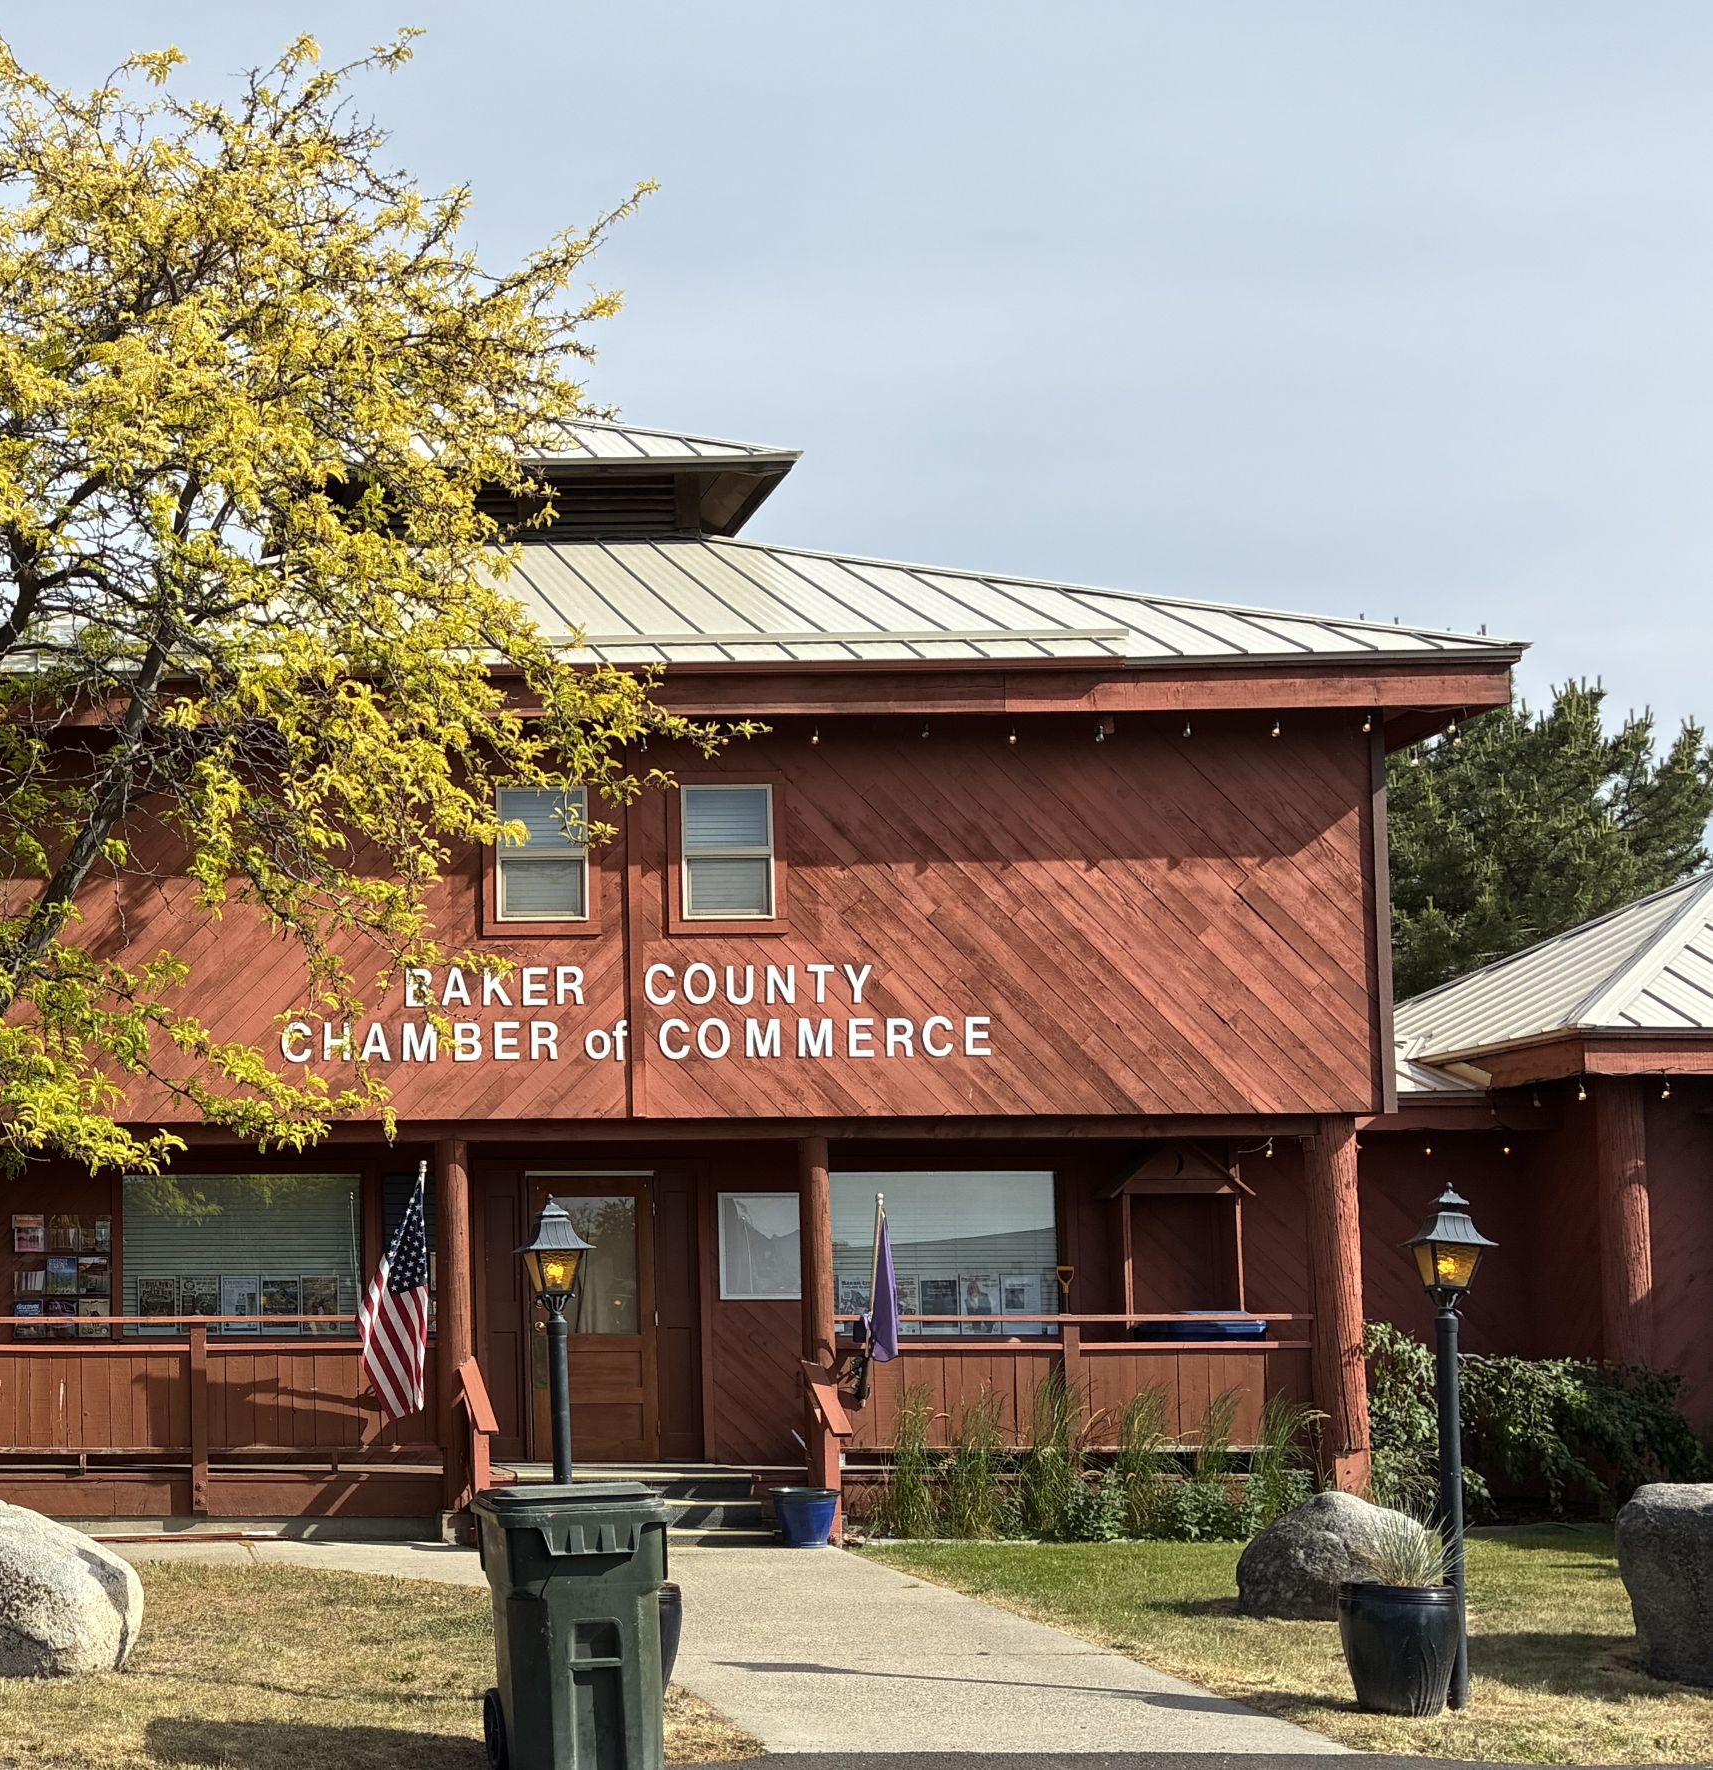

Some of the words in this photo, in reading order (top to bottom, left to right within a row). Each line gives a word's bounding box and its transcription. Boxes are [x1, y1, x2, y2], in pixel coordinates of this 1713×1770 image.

[404, 966, 587, 1009] BAKER
[644, 963, 873, 1005] COUNTY
[281, 1020, 560, 1064] CHAMBER
[585, 1019, 628, 1062] of
[659, 1016, 992, 1060] COMMERCE
